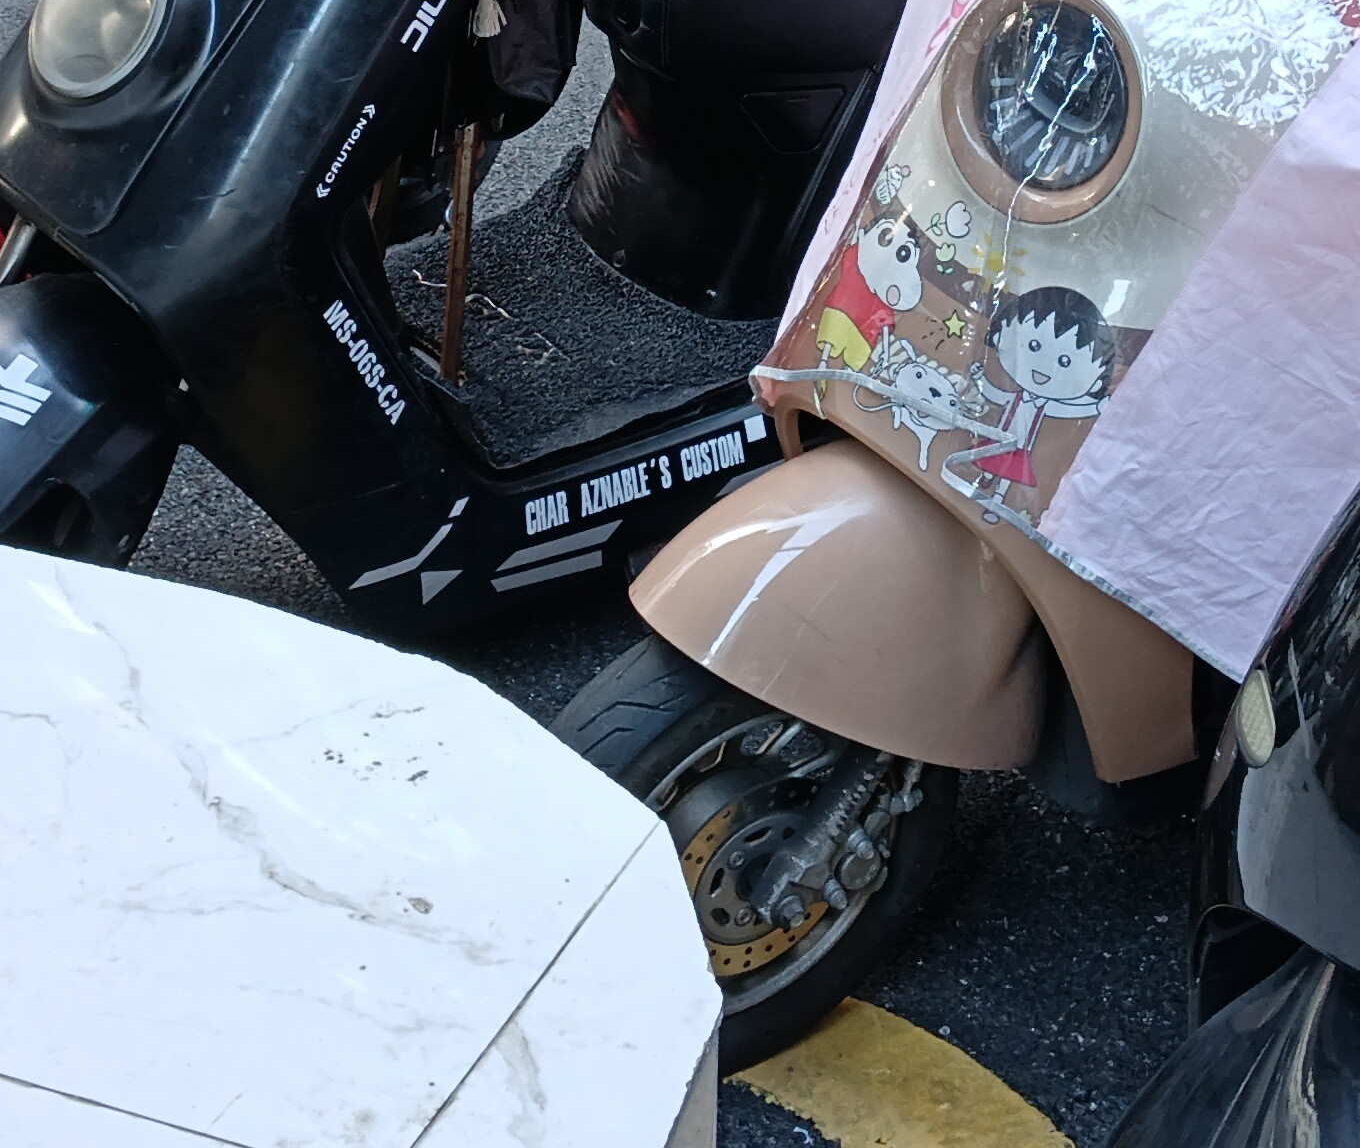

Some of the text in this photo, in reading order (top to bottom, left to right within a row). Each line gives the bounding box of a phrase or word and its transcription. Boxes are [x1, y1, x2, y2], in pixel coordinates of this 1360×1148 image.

[324, 116, 368, 185] CAUTION
[322, 299, 406, 426] MS-06S-CA
[525, 430, 746, 536] CHAR AZNABLE'S CUSTOM
